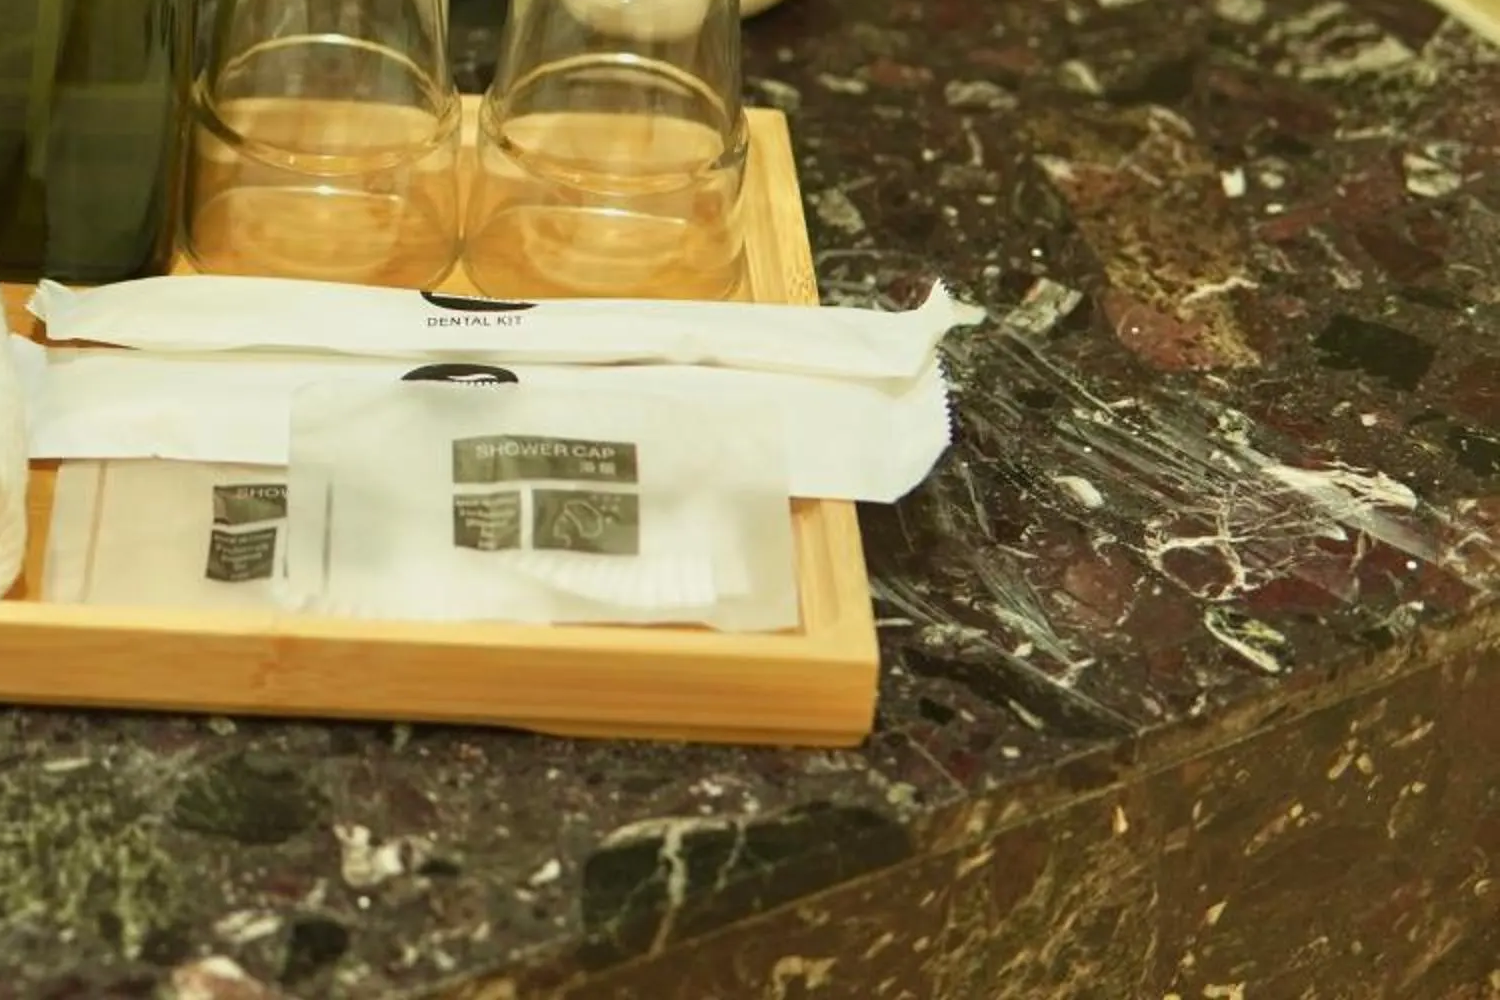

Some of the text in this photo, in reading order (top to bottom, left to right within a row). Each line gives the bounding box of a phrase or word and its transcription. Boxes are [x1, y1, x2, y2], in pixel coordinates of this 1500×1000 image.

[426, 315, 523, 327] DENTAL KIT
[475, 440, 616, 460] SHOWER CAP
